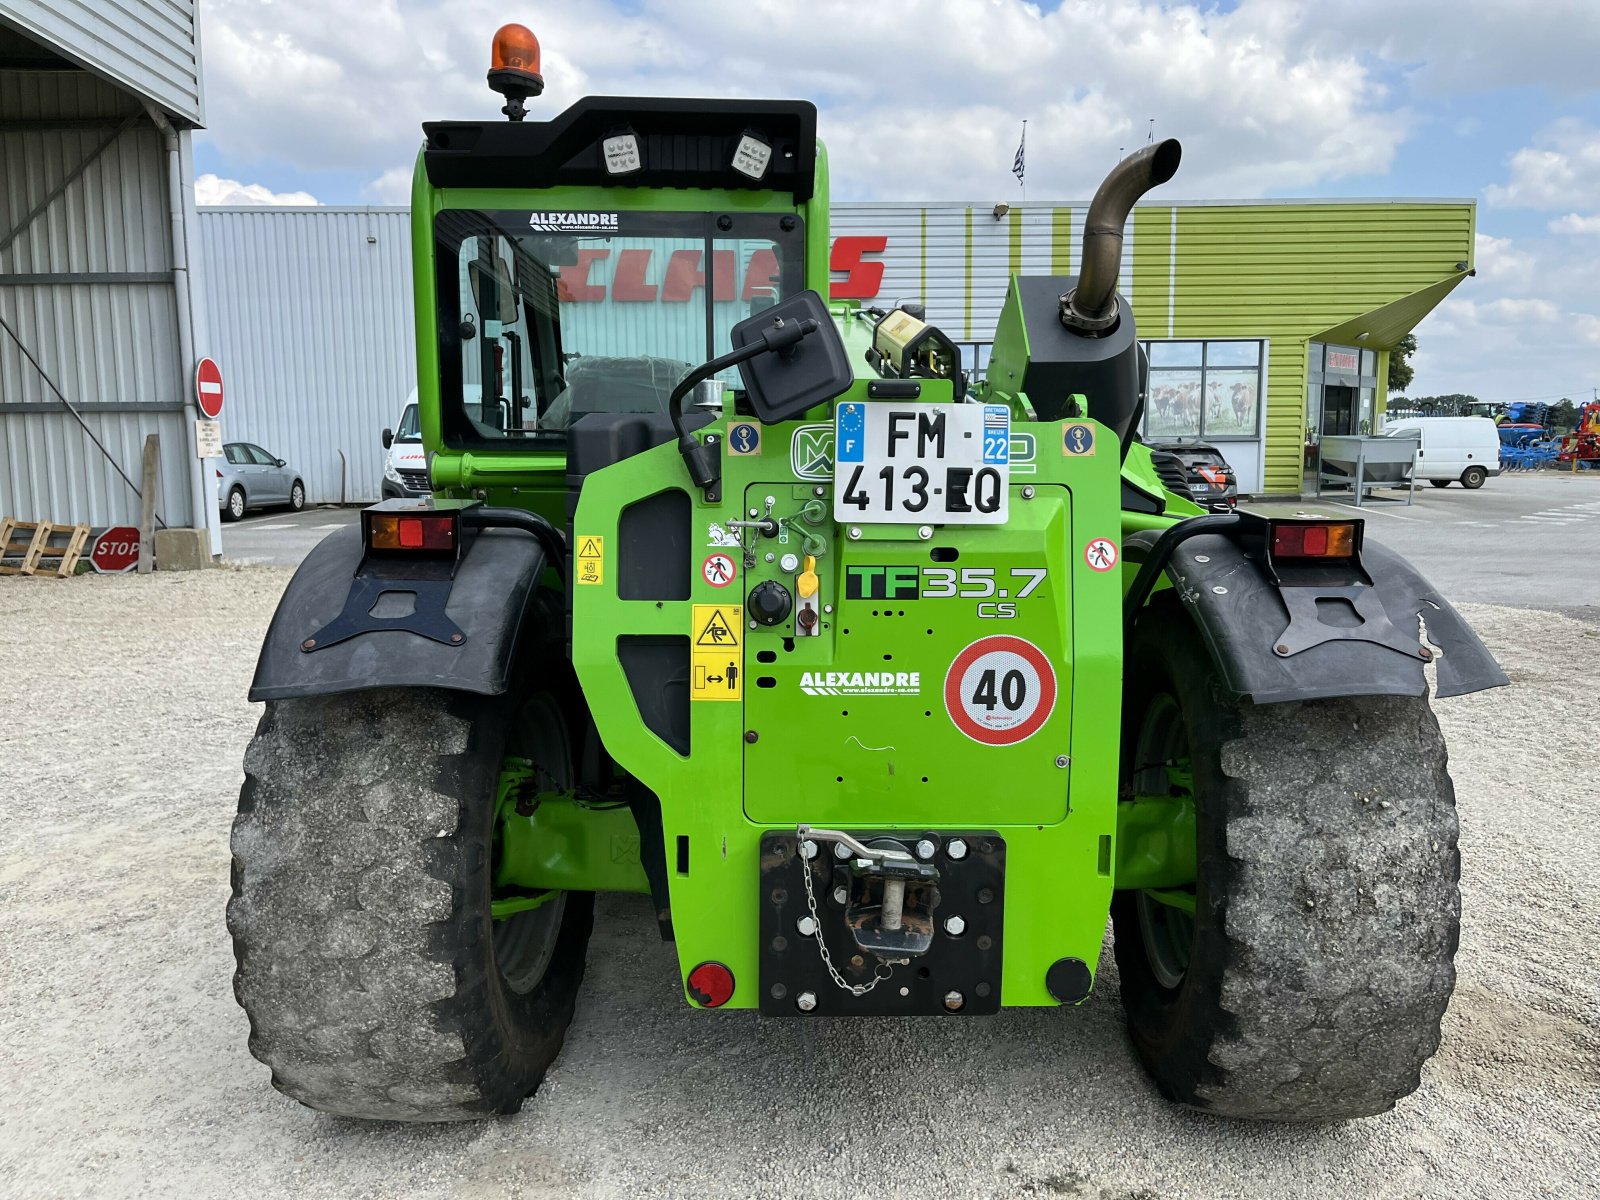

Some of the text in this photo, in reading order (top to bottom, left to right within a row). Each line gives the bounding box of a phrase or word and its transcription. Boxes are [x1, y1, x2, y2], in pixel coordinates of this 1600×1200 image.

[529, 212, 618, 225] ALEXANDRE
[846, 440, 855, 453] F
[984, 437, 1007, 460] 22
[97, 541, 140, 556] STOP
[976, 602, 1016, 618] CS
[800, 672, 920, 686] ALEXANDRE
[972, 669, 1026, 711] 40
